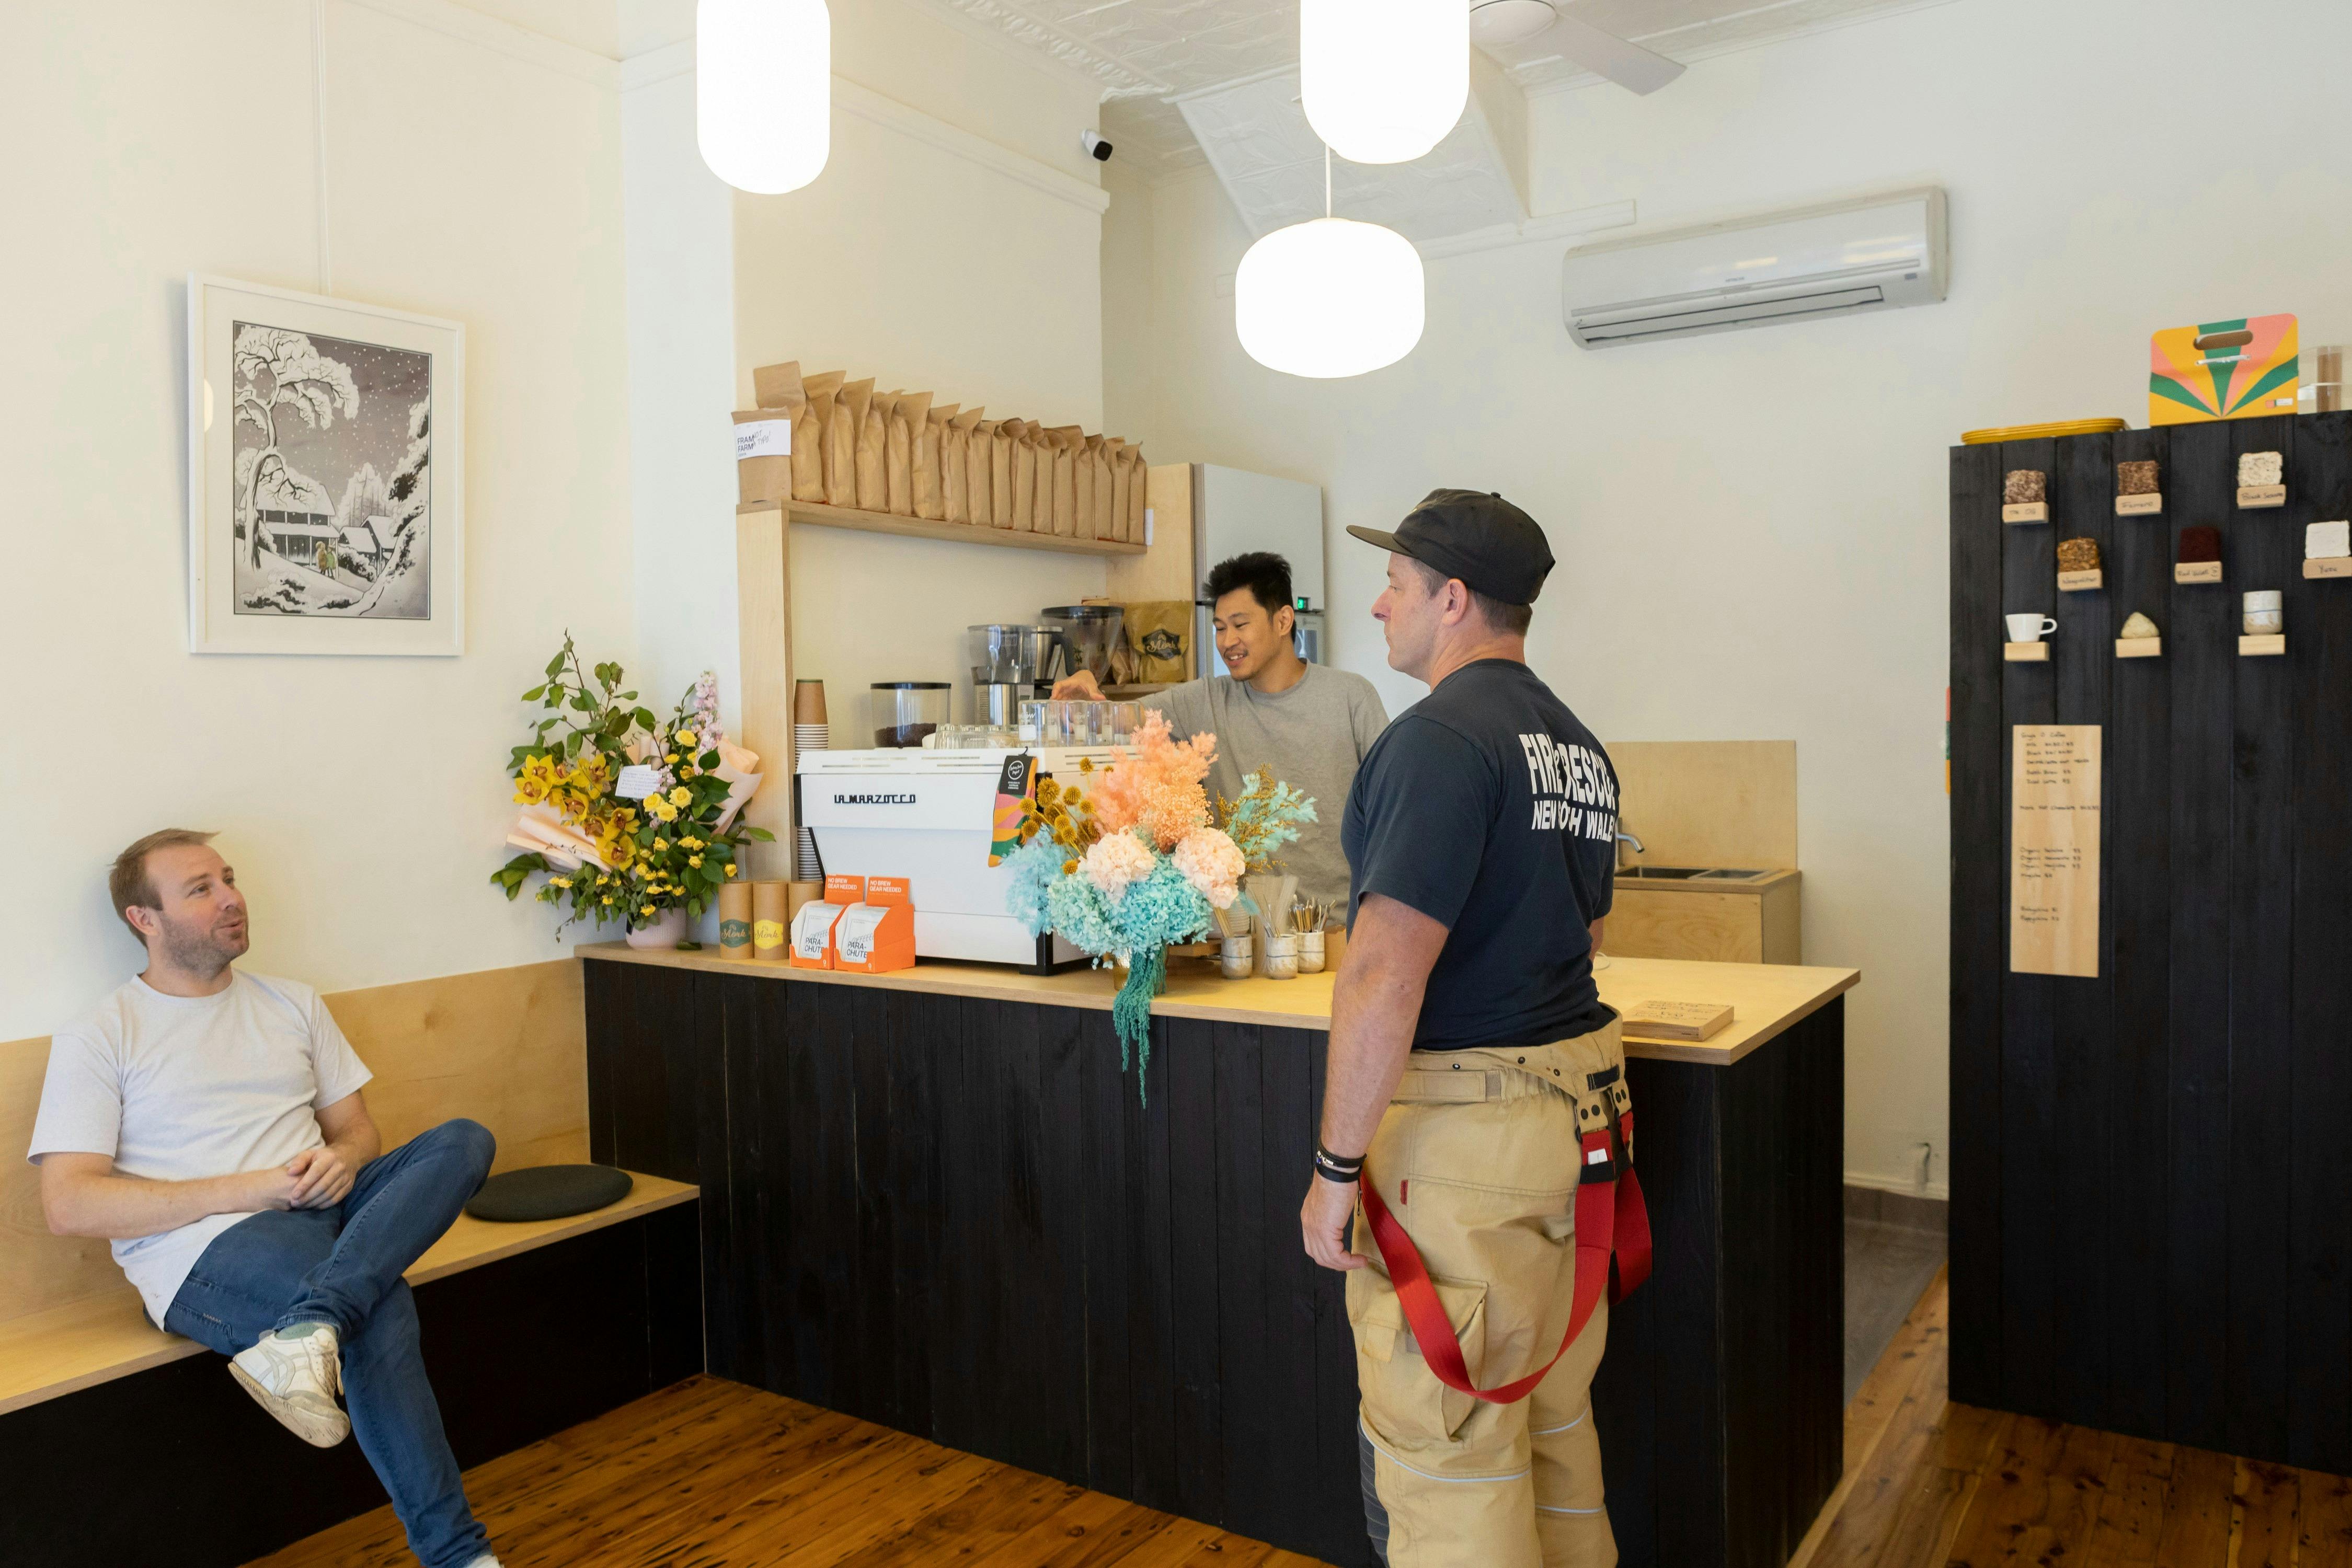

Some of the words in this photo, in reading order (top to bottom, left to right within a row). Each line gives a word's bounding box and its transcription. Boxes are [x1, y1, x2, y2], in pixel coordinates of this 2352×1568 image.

[737, 435, 754, 445] FRAM
[738, 443, 754, 453] FARM
[1557, 743, 1616, 811] RESCU
[805, 937, 823, 946] PARA-
[847, 941, 867, 950] PARA-
